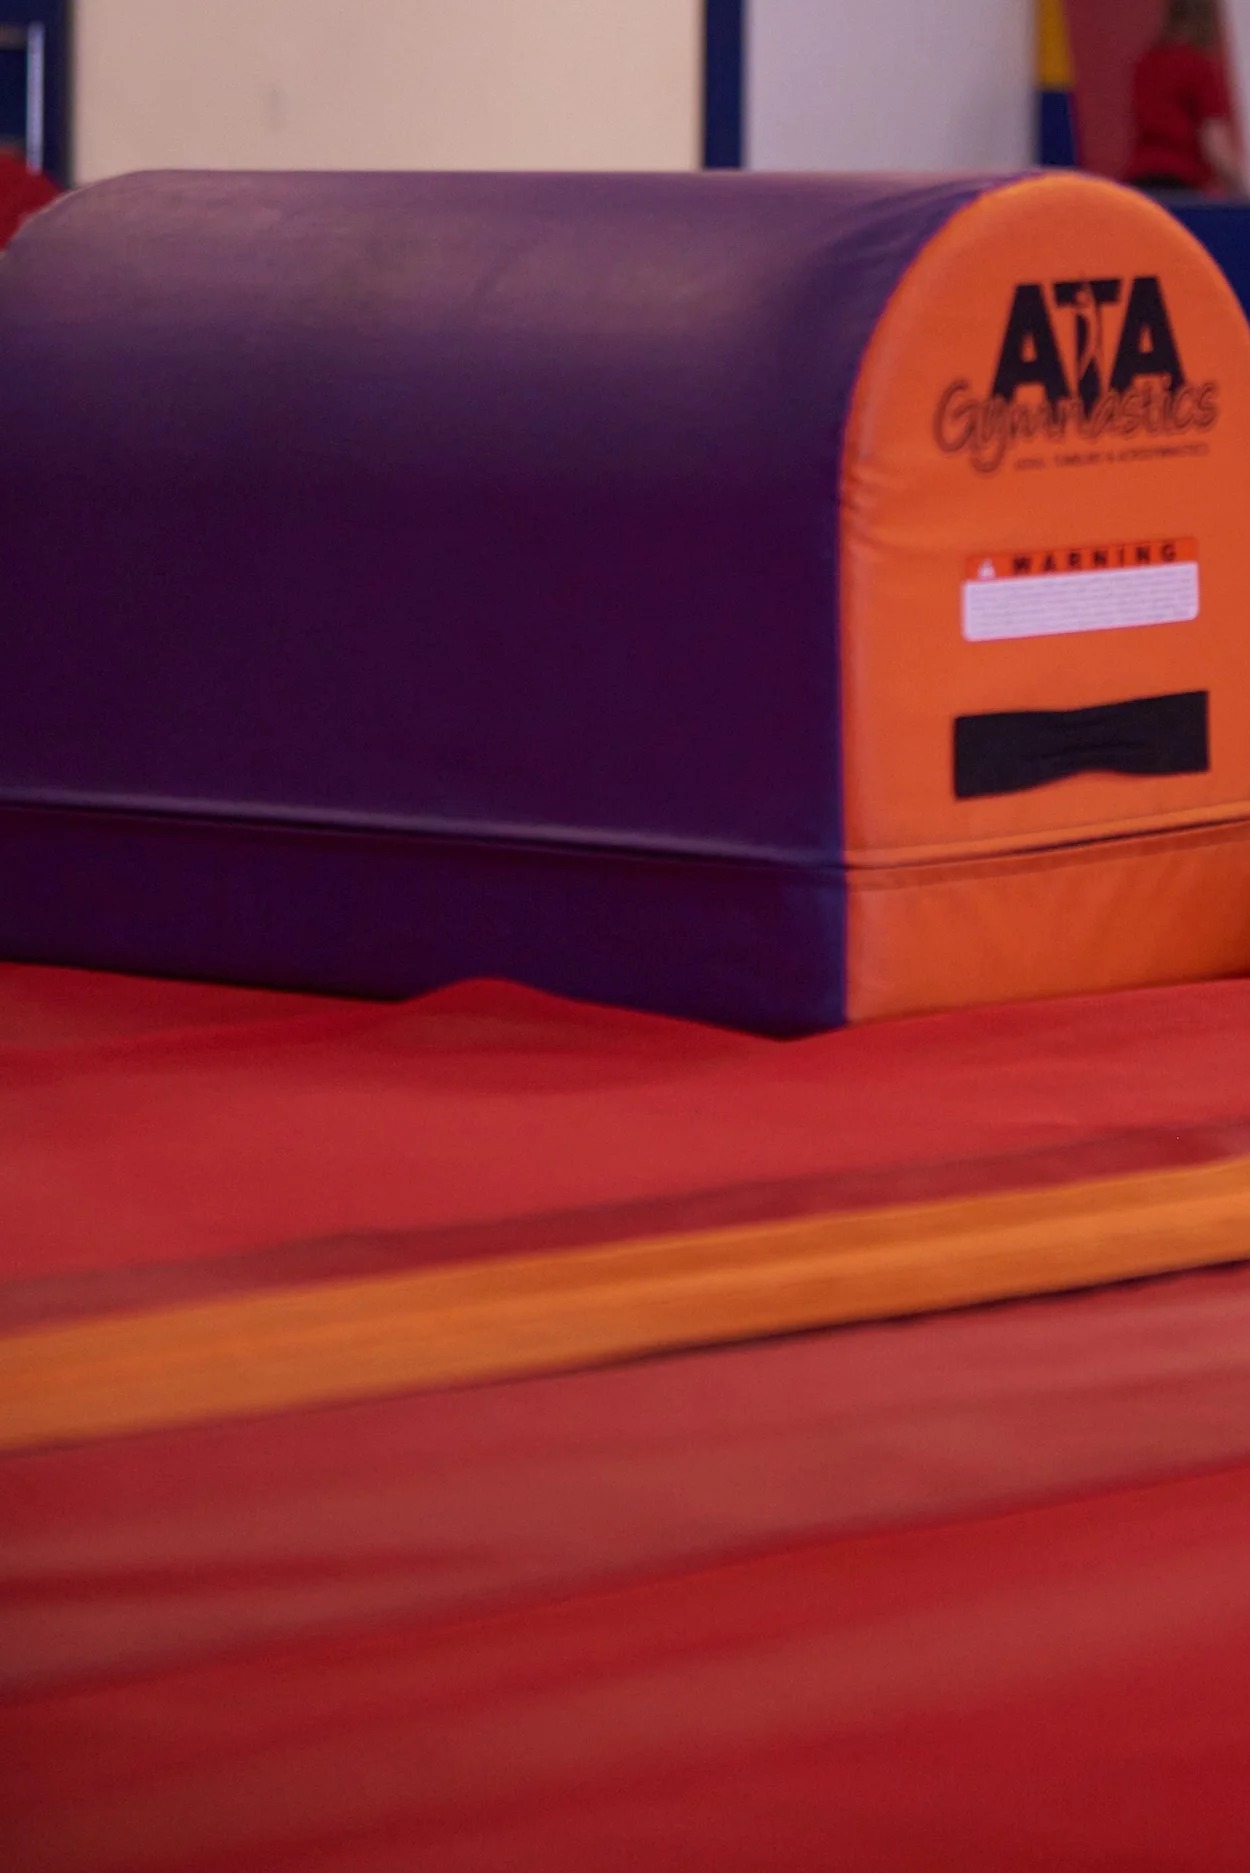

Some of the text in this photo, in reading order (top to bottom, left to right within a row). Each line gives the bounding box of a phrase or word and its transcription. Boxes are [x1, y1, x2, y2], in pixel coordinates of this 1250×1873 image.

[991, 275, 1187, 422] ATA
[933, 379, 1218, 473] Gymnastics
[1012, 543, 1177, 574] WARNING
